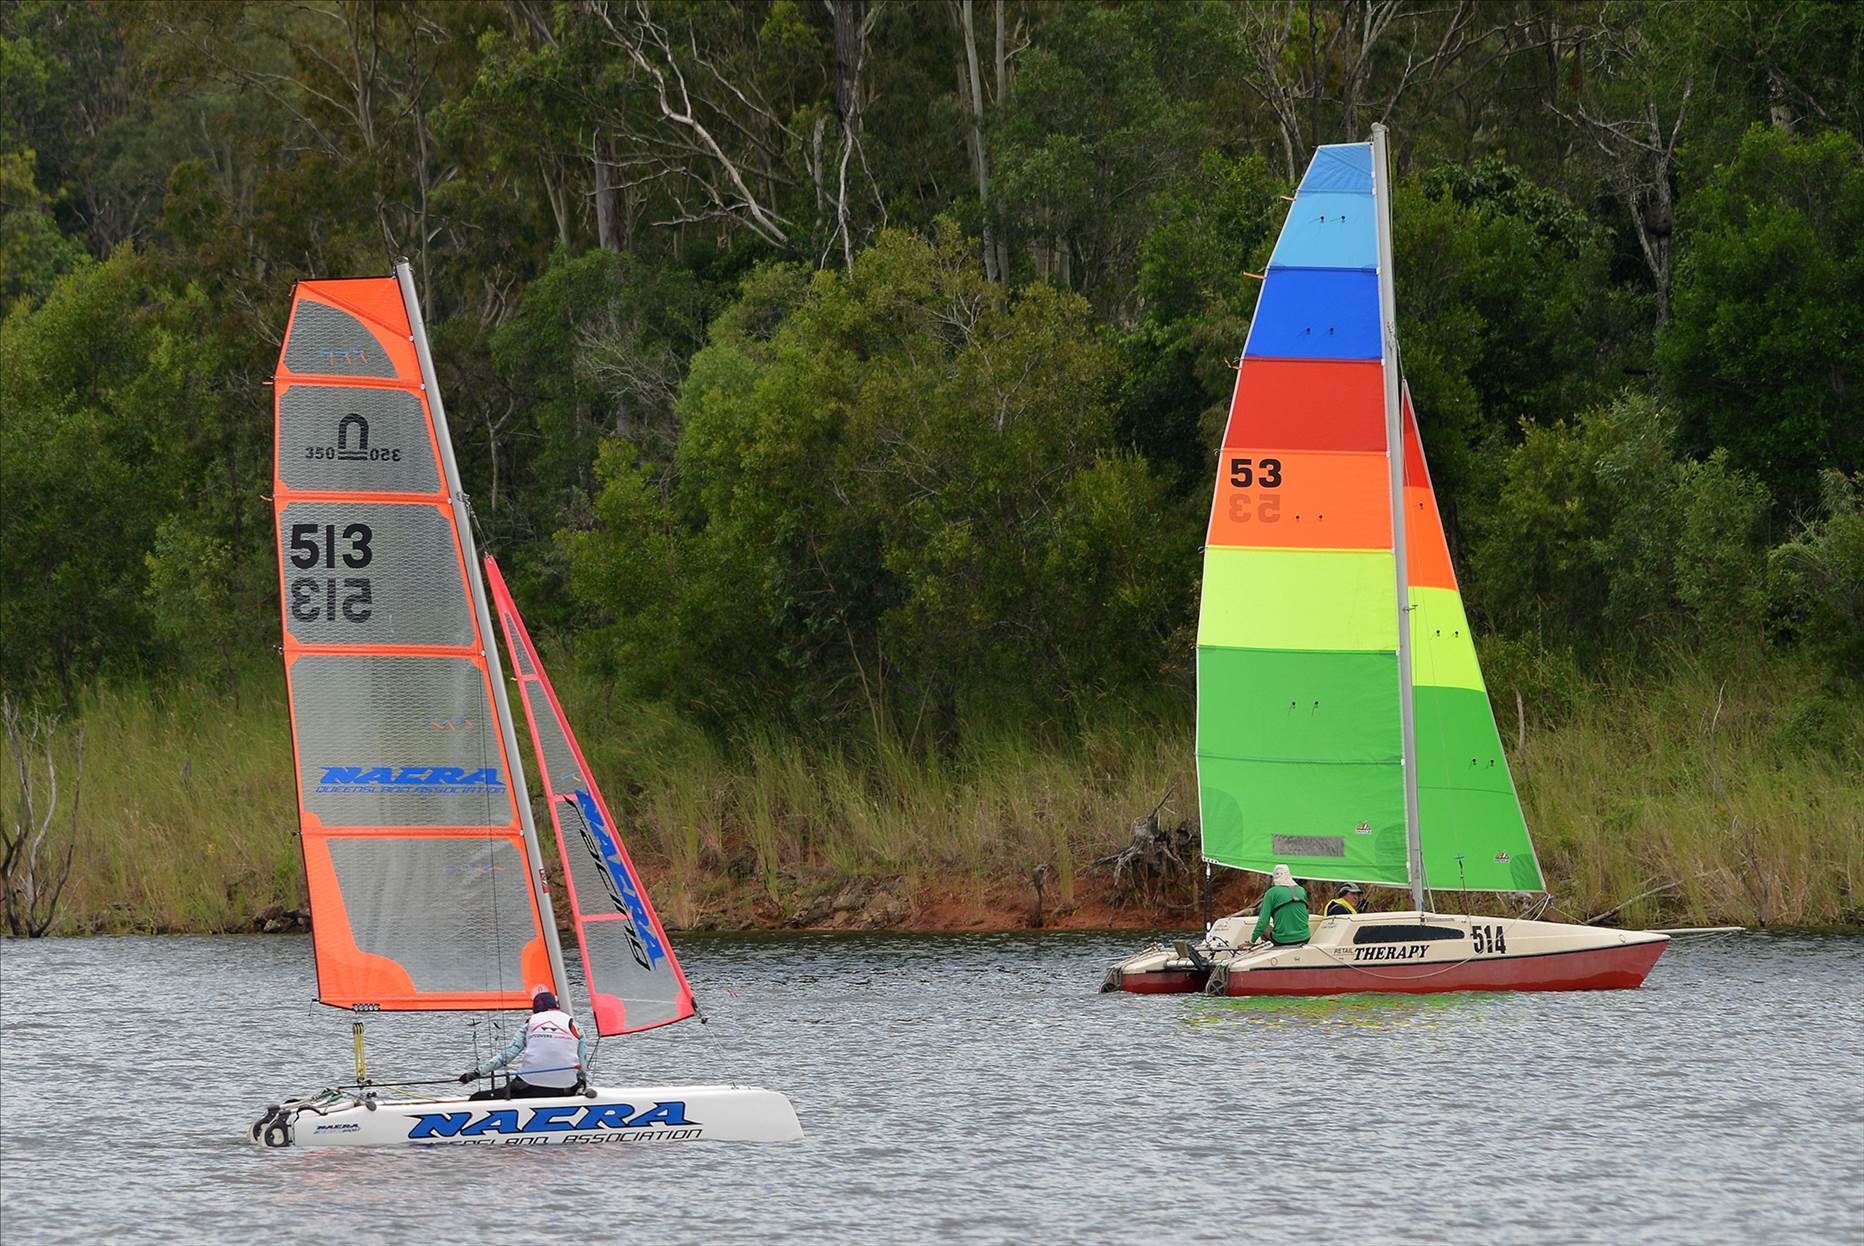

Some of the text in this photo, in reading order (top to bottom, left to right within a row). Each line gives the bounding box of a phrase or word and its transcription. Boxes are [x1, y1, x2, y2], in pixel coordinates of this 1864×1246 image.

[305, 446, 336, 460] 350
[1230, 458, 1282, 488] 53
[290, 523, 373, 570] 513
[320, 766, 507, 786] NACRA
[574, 787, 665, 970] NACRA
[1353, 944, 1430, 961] THERAPY
[1470, 925, 1507, 954] 514
[402, 1101, 703, 1139] NACRA
[561, 1128, 703, 1145] ASSOCIATION
